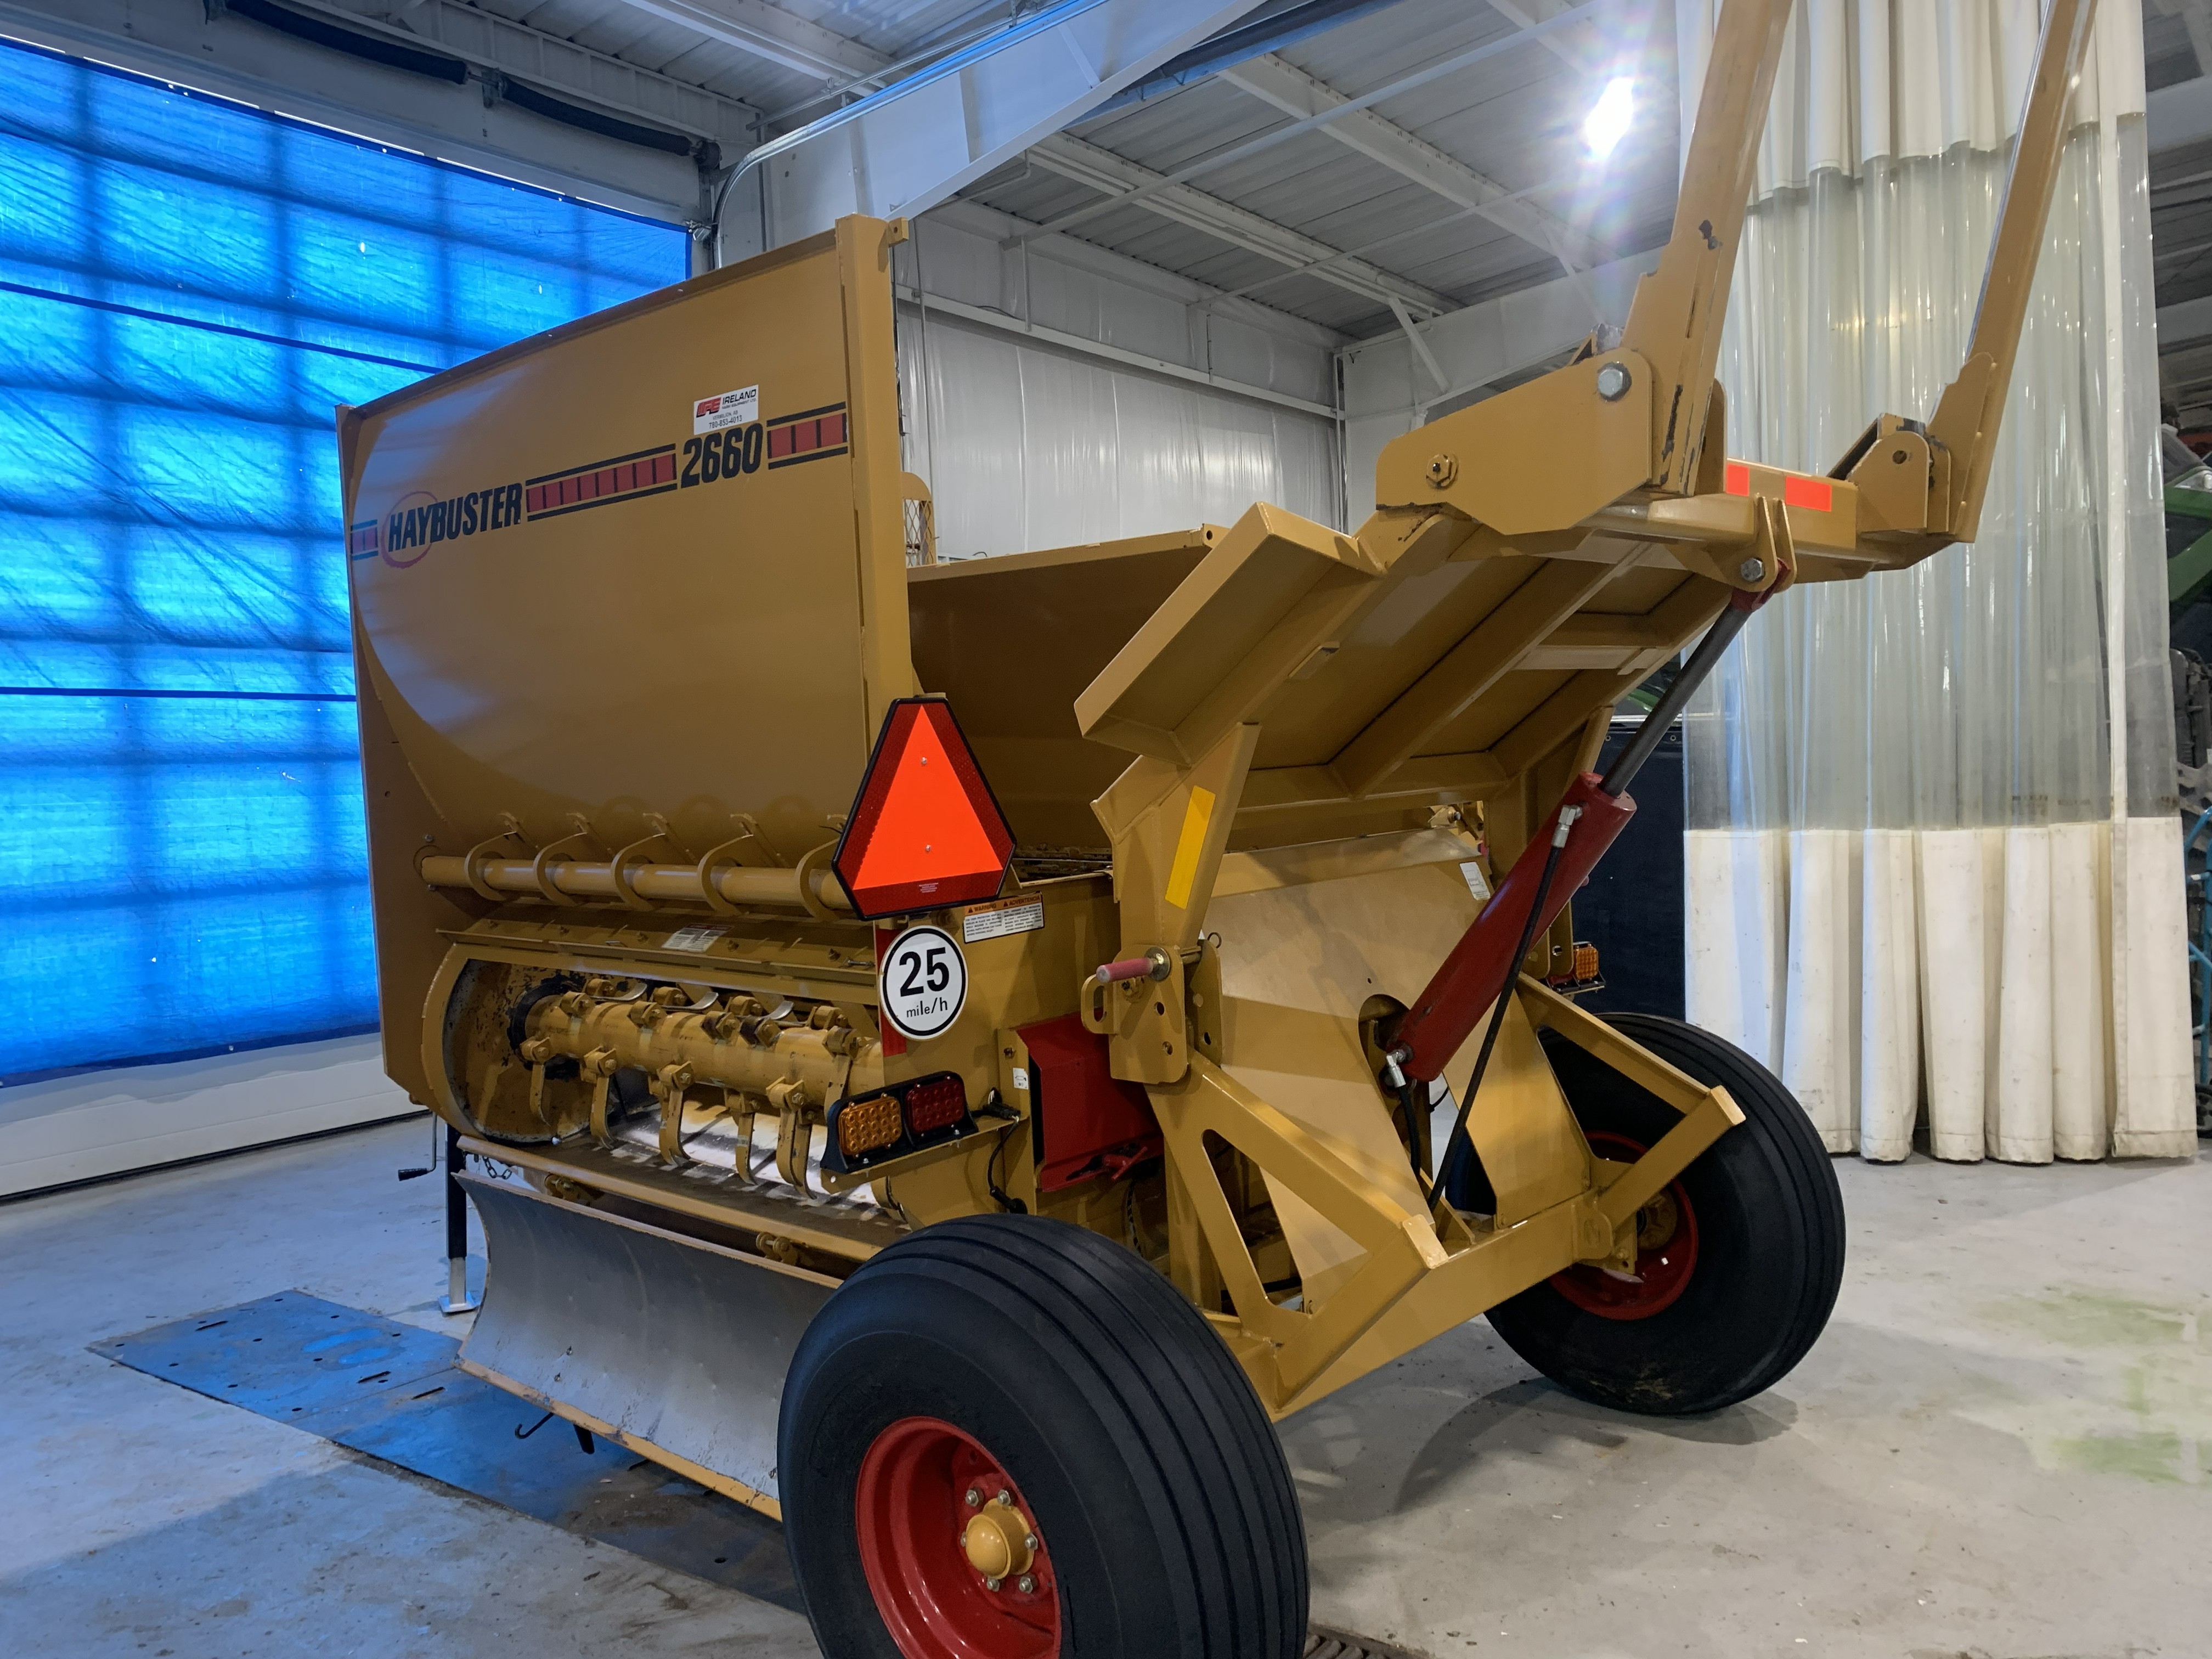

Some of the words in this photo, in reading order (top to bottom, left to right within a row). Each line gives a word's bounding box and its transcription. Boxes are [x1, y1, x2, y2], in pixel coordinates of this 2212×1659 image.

[722, 389, 757, 405] IRELAND
[709, 415, 742, 429] 780-853-4013
[681, 423, 763, 488] 2660
[388, 482, 522, 552] HAYBUSTER
[974, 903, 997, 912] WARNING
[1009, 895, 1040, 906] ADVERTENCIA
[899, 947, 950, 997] 25
[906, 997, 948, 1018] mile/h
